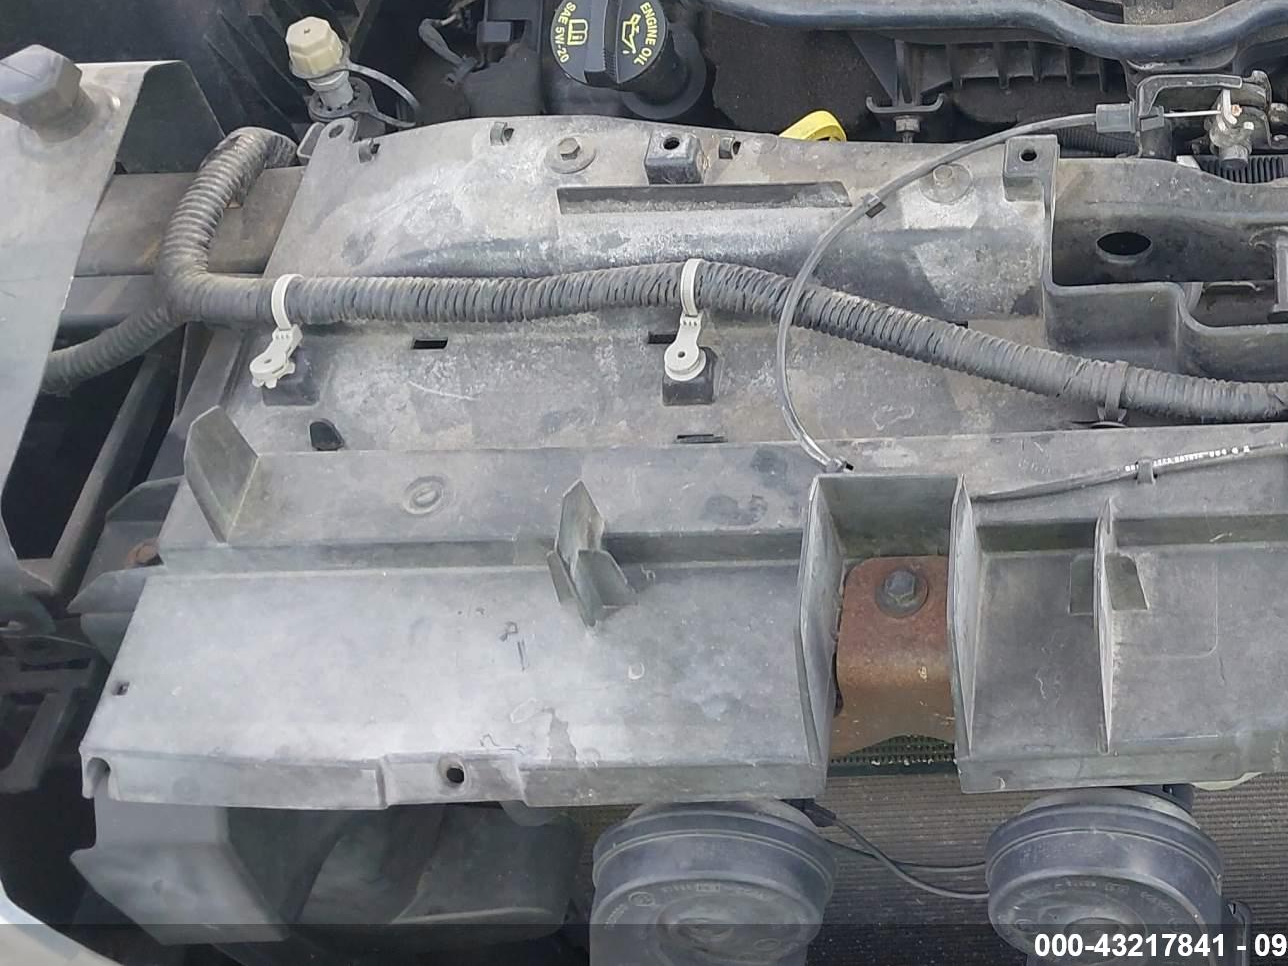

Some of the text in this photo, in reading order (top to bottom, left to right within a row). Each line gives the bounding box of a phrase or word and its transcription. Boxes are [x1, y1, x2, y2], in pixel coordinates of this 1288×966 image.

[553, 1, 577, 63] SAE 5W-20
[633, 1, 659, 66] ENGINE OIL
